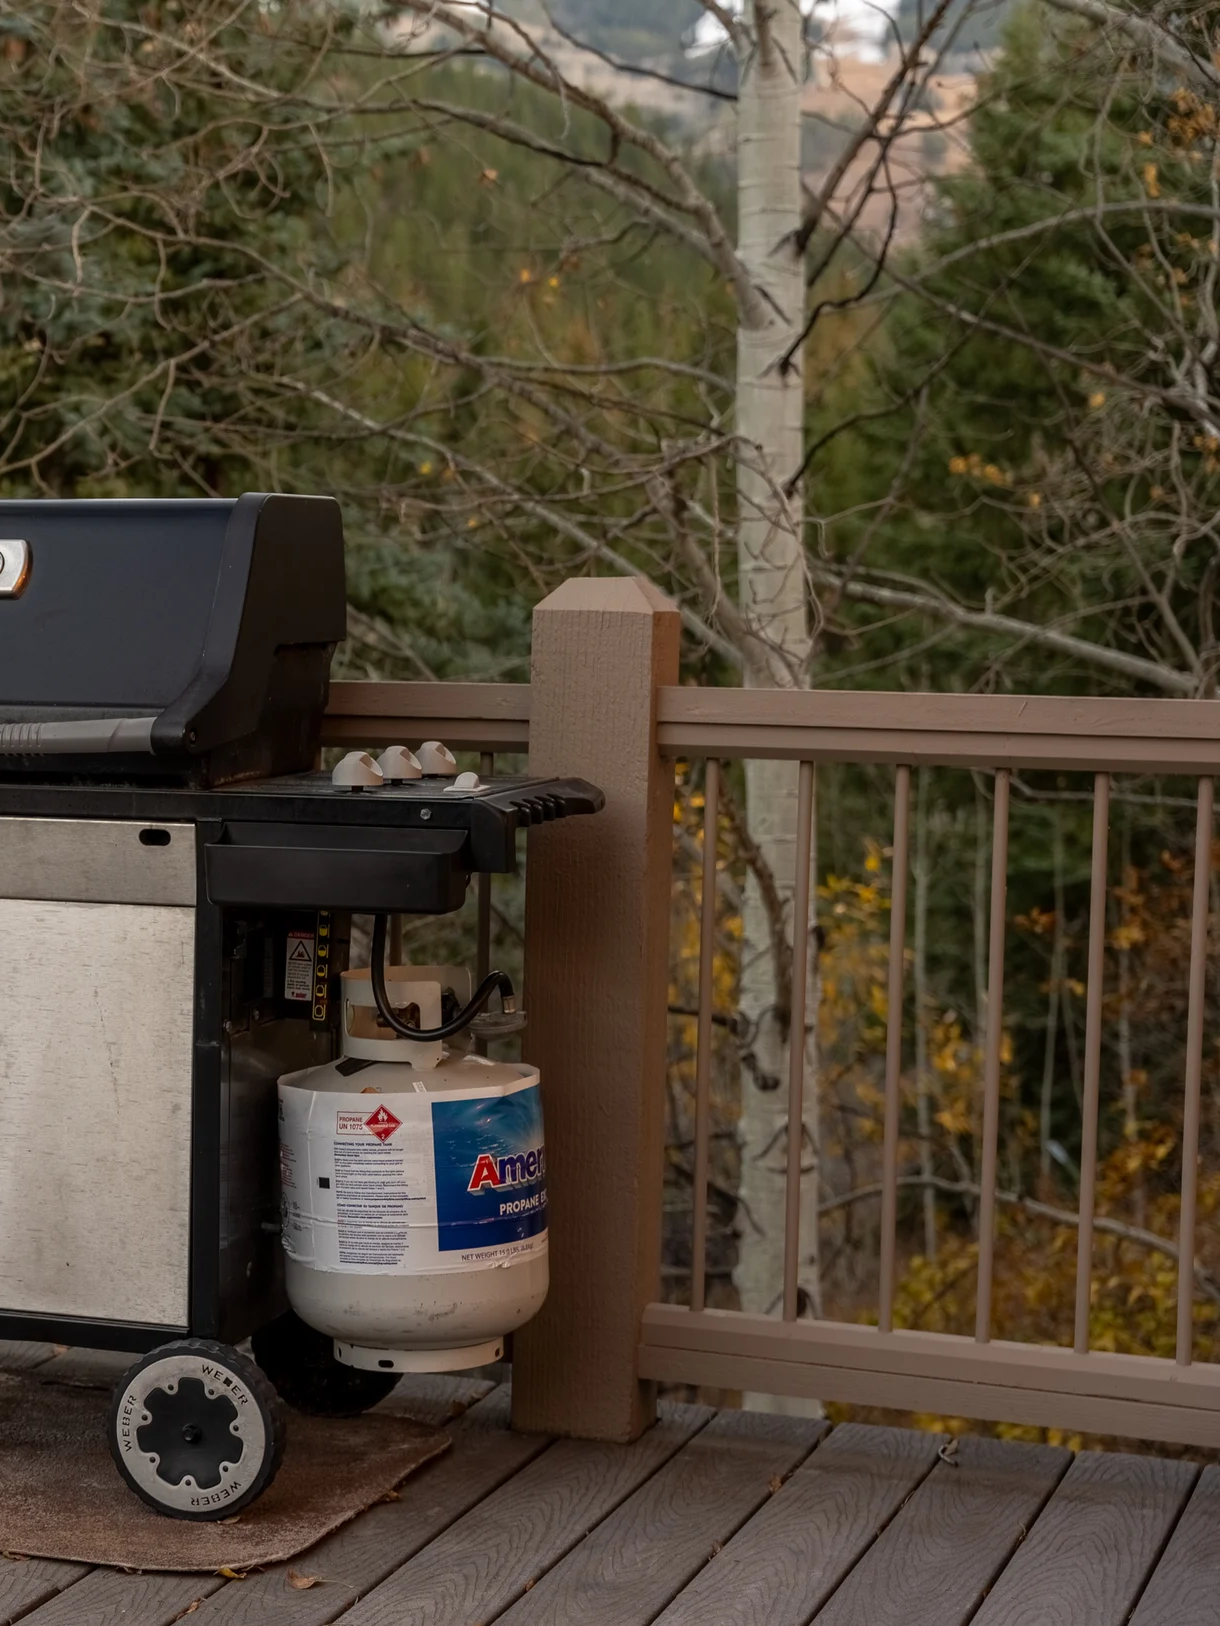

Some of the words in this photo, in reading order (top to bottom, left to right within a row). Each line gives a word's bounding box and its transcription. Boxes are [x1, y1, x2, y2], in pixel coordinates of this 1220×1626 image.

[468, 1146, 546, 1192] Amer
[500, 1194, 539, 1215] PROPANE
[461, 1253, 474, 1261] NET
[474, 1250, 498, 1260] WEIGHT
[122, 1395, 137, 1452] WEBER
[191, 1481, 241, 1506] WEBER
